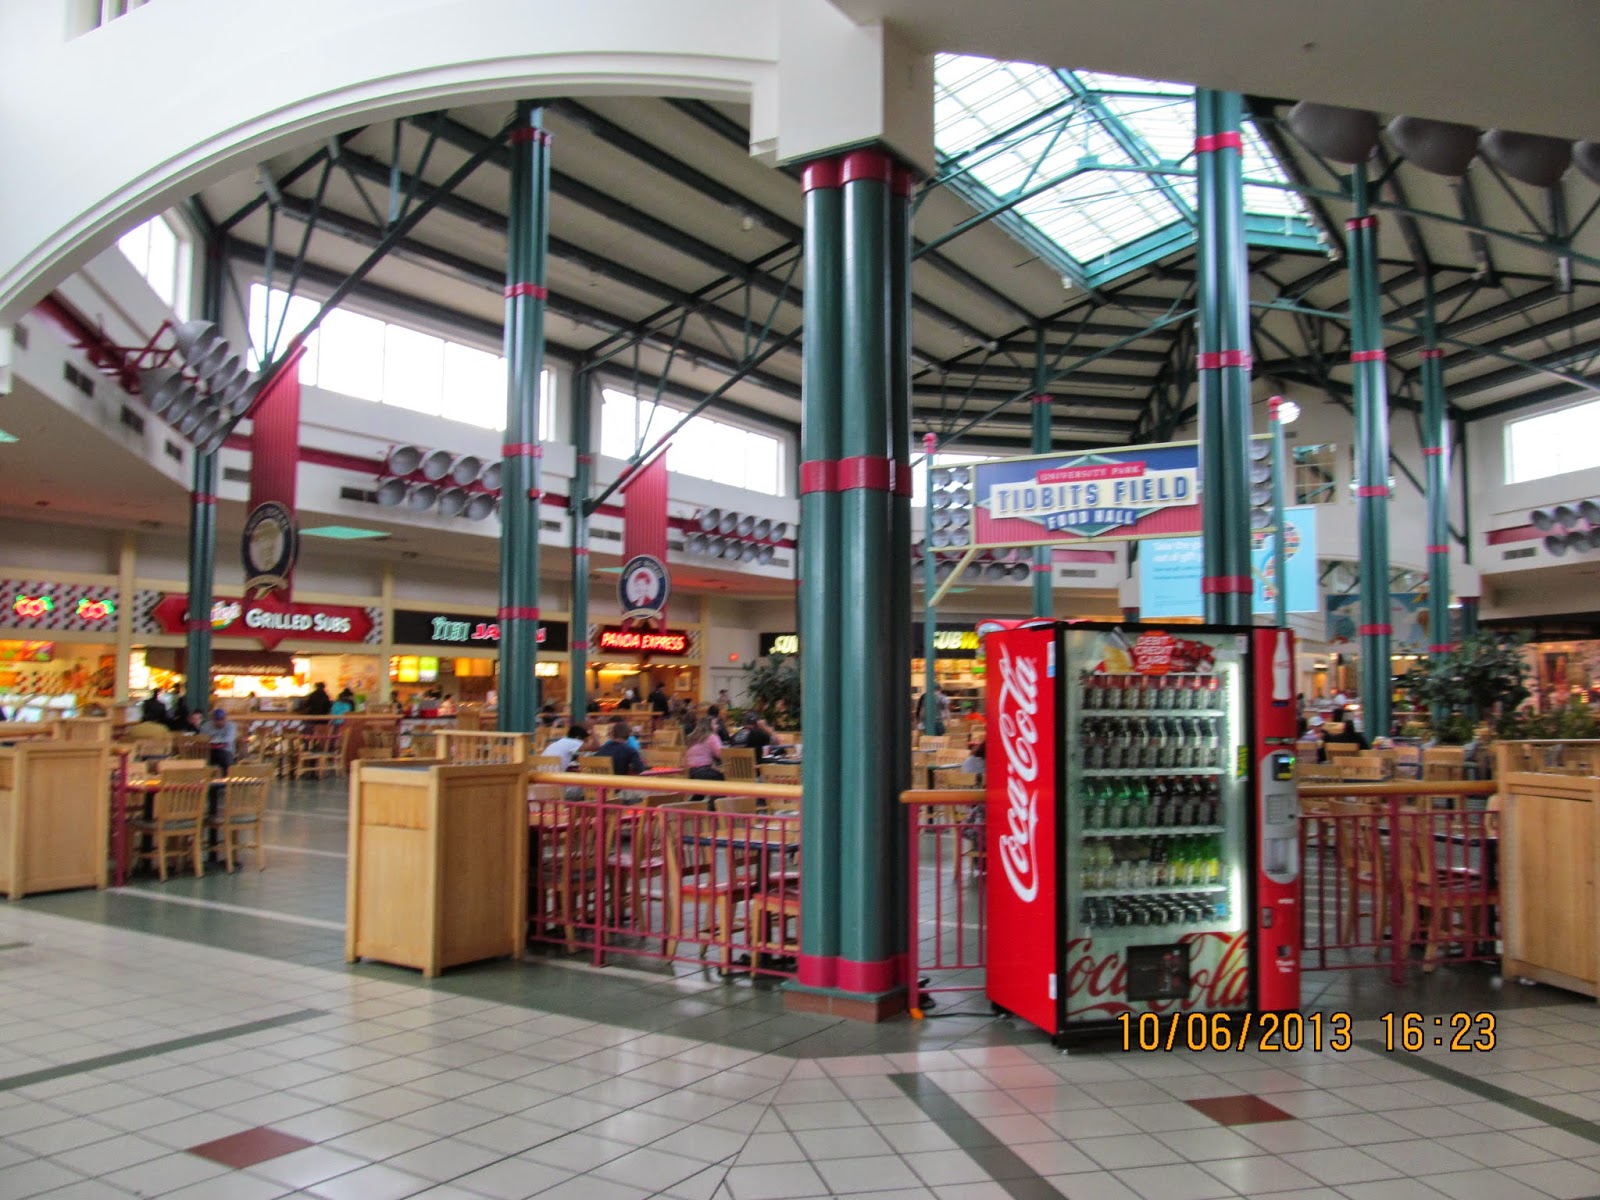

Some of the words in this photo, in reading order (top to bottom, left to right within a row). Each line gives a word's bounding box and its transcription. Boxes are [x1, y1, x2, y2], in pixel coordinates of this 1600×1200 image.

[1039, 468, 1107, 481] UNIVERSITY
[1111, 464, 1141, 475] PARK
[998, 483, 1099, 513] TIDBITS
[1114, 475, 1189, 505] FIELD
[1047, 510, 1090, 530] FOOD
[1094, 509, 1135, 524] HALL
[245, 608, 313, 631] GRILLED
[313, 613, 352, 633] SUBS
[601, 632, 640, 648] PANDA
[641, 634, 685, 651] EXPRESS
[1136, 636, 1171, 646] DEBIT
[1134, 646, 1175, 656] CREDIT
[1138, 655, 1170, 665] CARD
